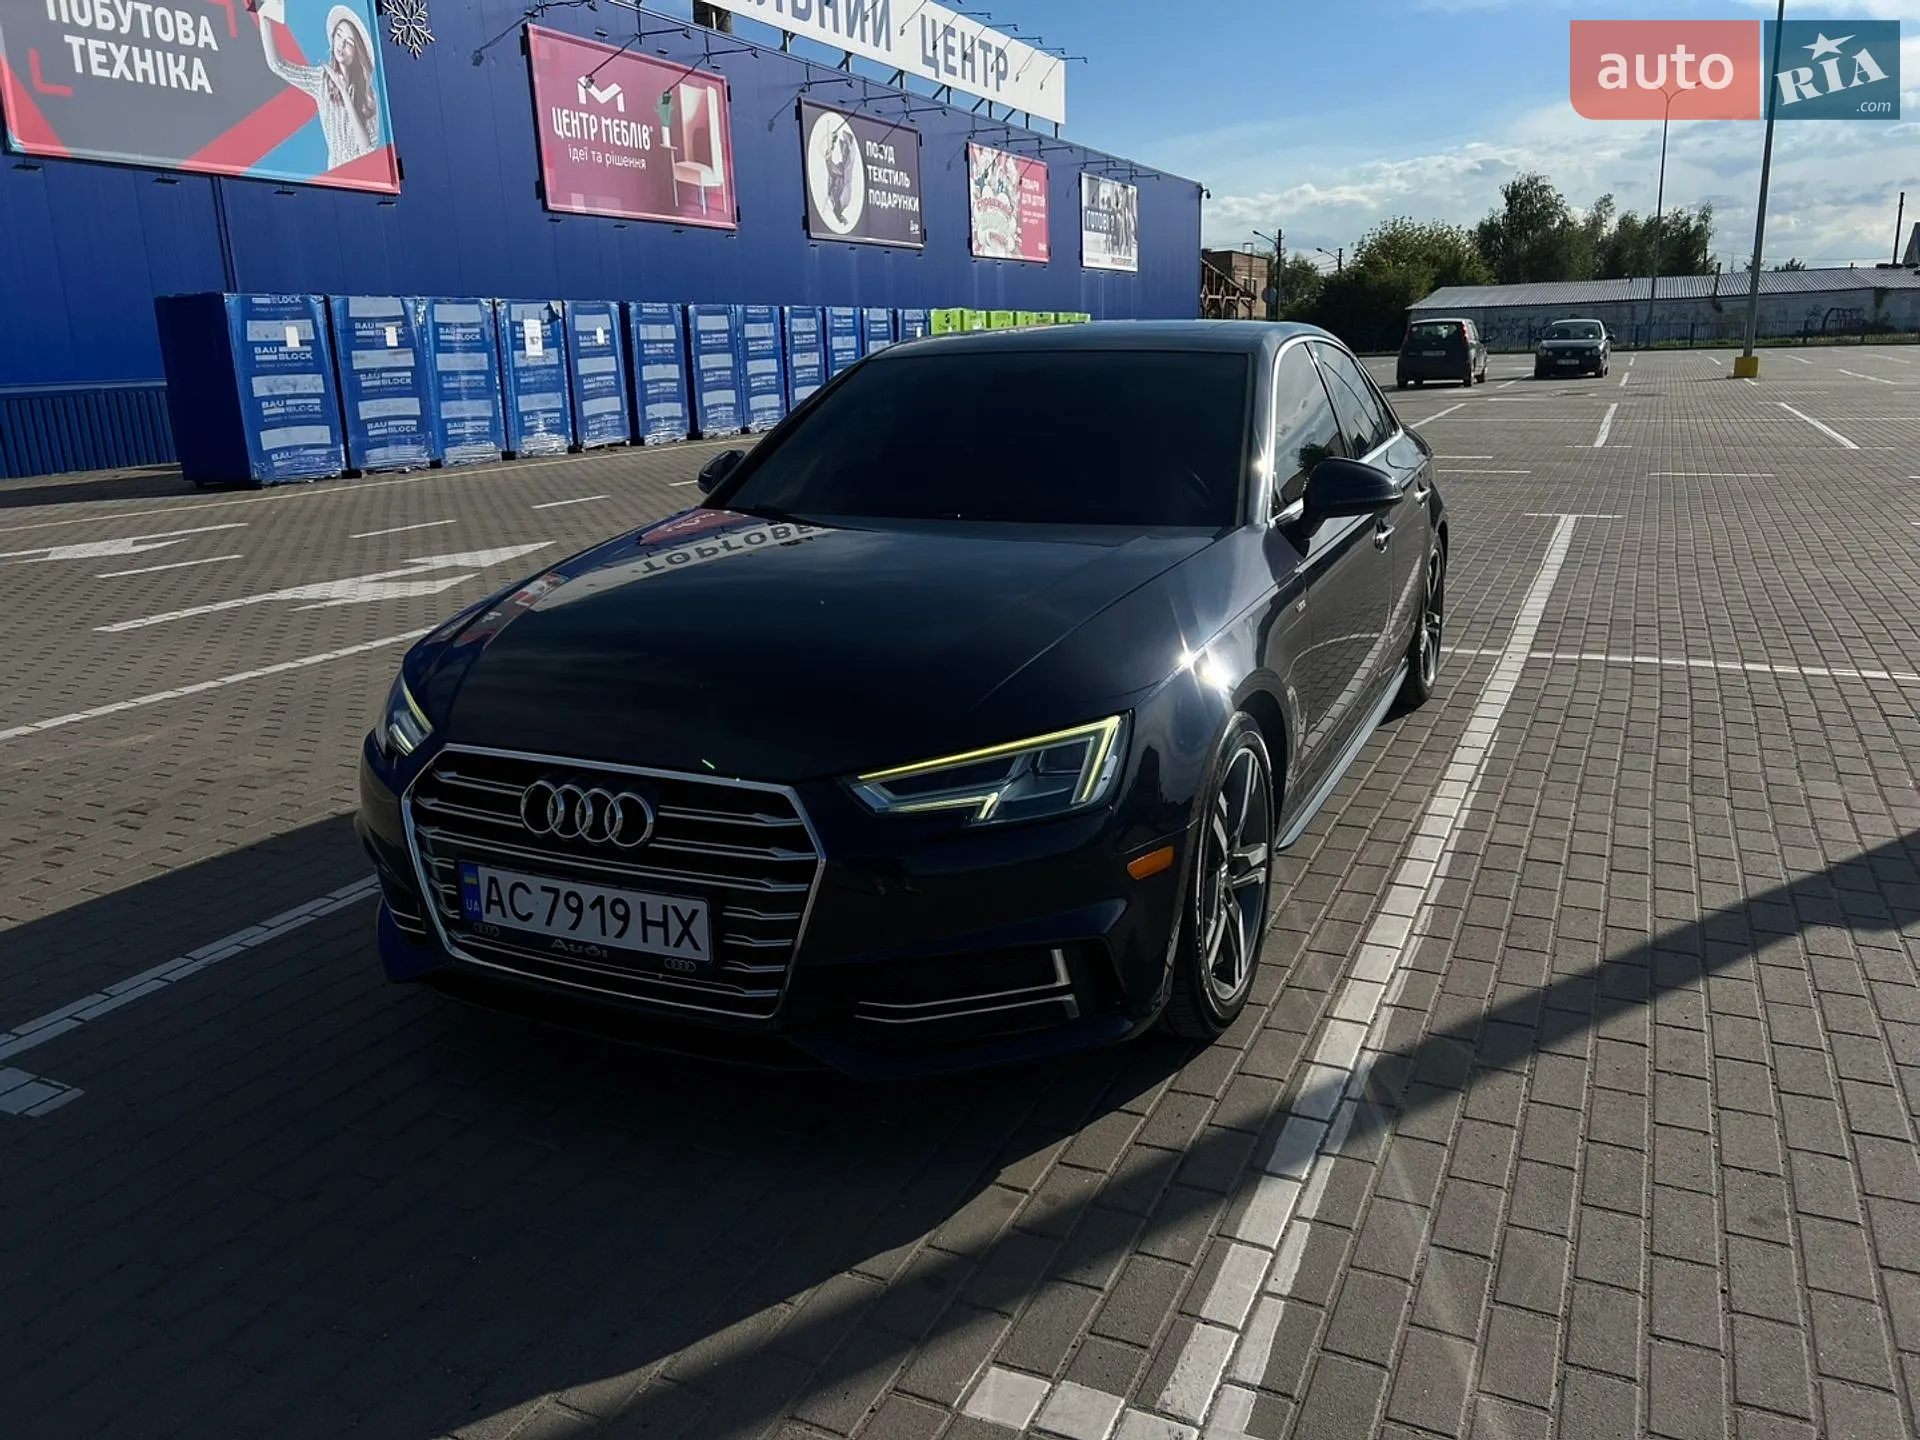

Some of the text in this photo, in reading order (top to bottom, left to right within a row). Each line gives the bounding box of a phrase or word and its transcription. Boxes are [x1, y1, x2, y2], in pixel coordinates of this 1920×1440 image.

[47, 0, 219, 51] ПОБУТОВА
[920, 13, 1009, 92] ЦЕНТР
[64, 34, 213, 94] ТЕХНІКА
[552, 106, 652, 151] ЦЕНТР МЕБЛІВ
[568, 144, 647, 170] ідеї та рішення
[865, 140, 897, 165] ПОСУД
[866, 164, 911, 189] ТЕКСТИЛЬ
[868, 188, 920, 213] ПОДАРУНКИ
[354, 321, 375, 329] BAU
[254, 346, 277, 354] BAU
[279, 352, 314, 360] BLOCK
[381, 377, 412, 385] BLOCK
[262, 400, 284, 409] BAU
[286, 404, 322, 413] BLOCK
[388, 425, 417, 433] BLOCK
[465, 899, 480, 913] UA
